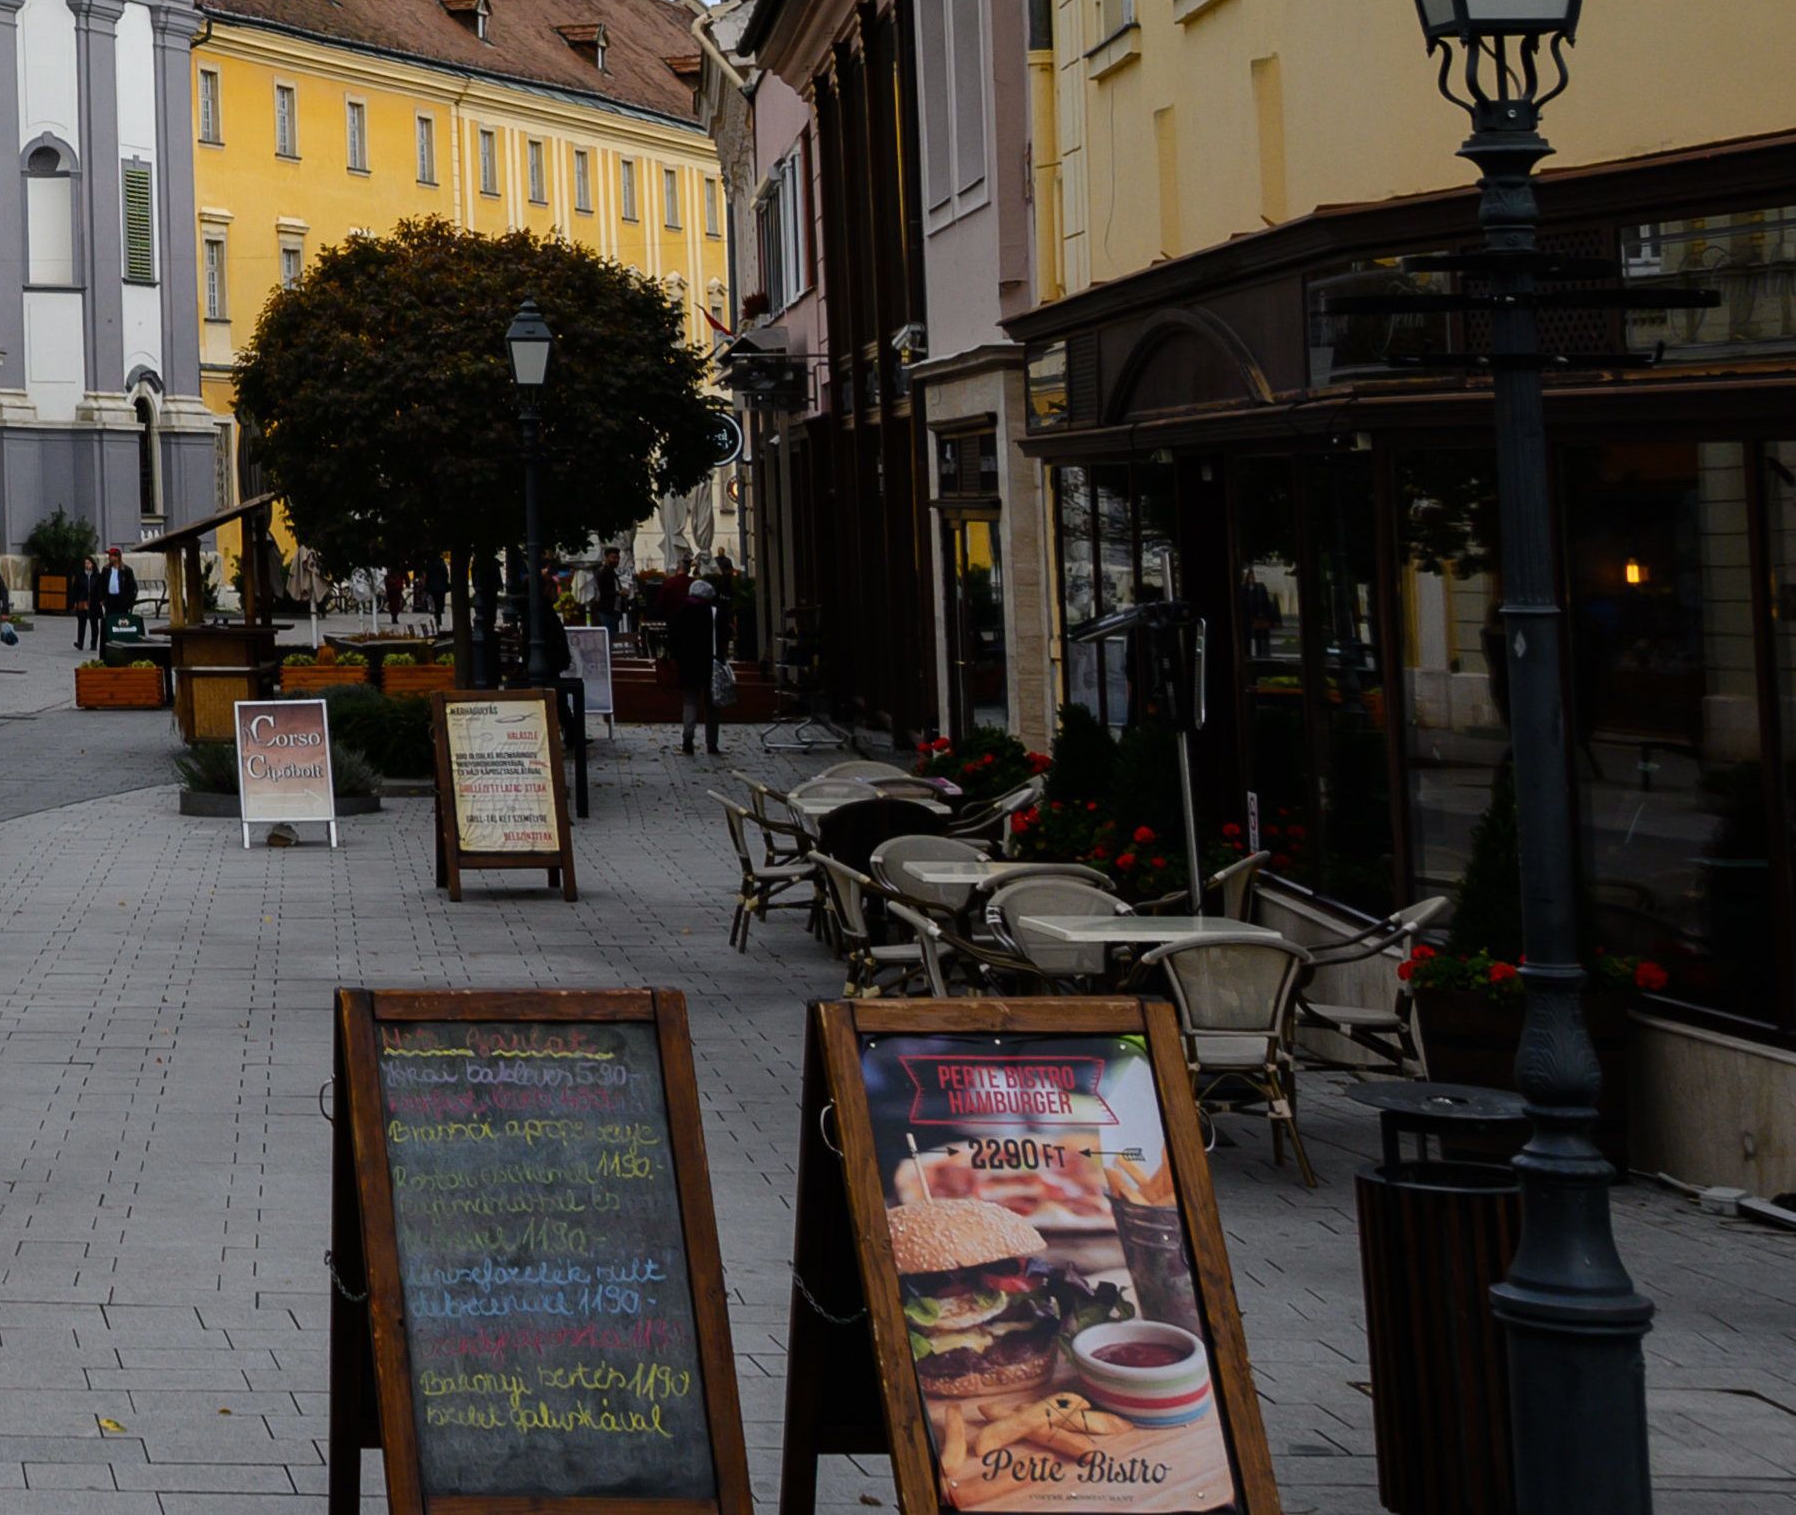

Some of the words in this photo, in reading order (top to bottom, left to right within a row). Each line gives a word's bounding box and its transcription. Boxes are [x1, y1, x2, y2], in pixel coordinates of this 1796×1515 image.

[250, 714, 321, 747] Corso
[248, 754, 324, 782] Cipőbolt
[937, 1065, 999, 1089] PERTE
[1004, 1065, 1075, 1090] BISTRO
[948, 1090, 1073, 1115] HAMBURGER
[968, 1139, 1038, 1170] 2290
[1044, 1144, 1065, 1168] FT
[982, 1448, 1066, 1482] Perte
[1078, 1450, 1173, 1484] Bistro
